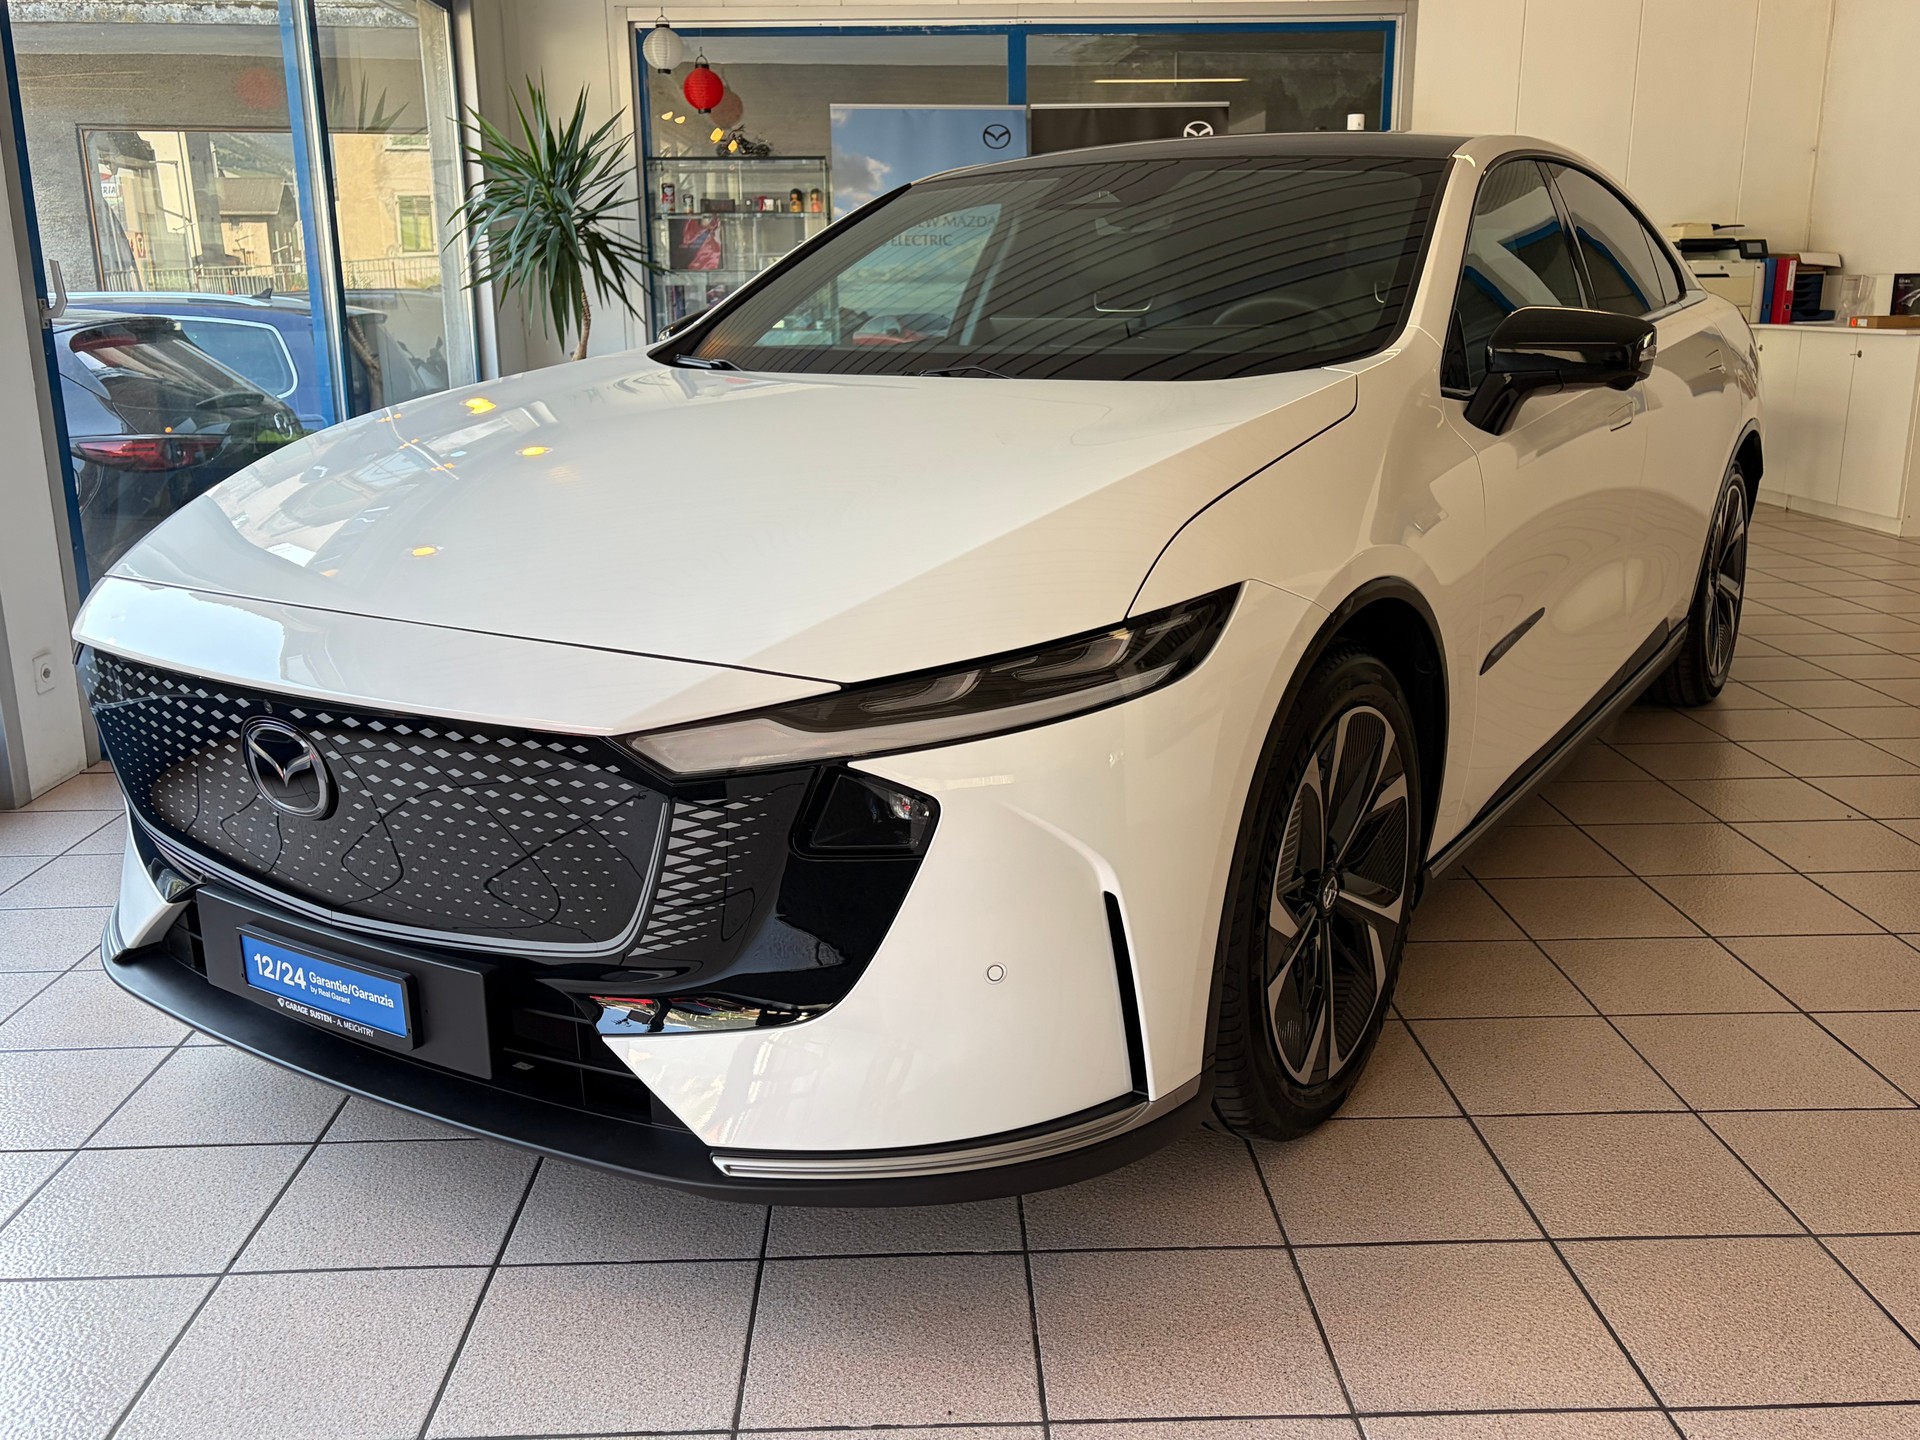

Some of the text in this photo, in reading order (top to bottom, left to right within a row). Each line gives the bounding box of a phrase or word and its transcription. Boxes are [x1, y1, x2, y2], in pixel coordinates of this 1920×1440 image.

[253, 953, 307, 990] 12/24
[308, 971, 395, 1009] Garantie/Garanzia
[309, 985, 318, 995] by
[285, 1001, 309, 1016] GARAGE
[309, 1009, 333, 1025] SUSTEN
[343, 1021, 375, 1038] MEICHTRY
